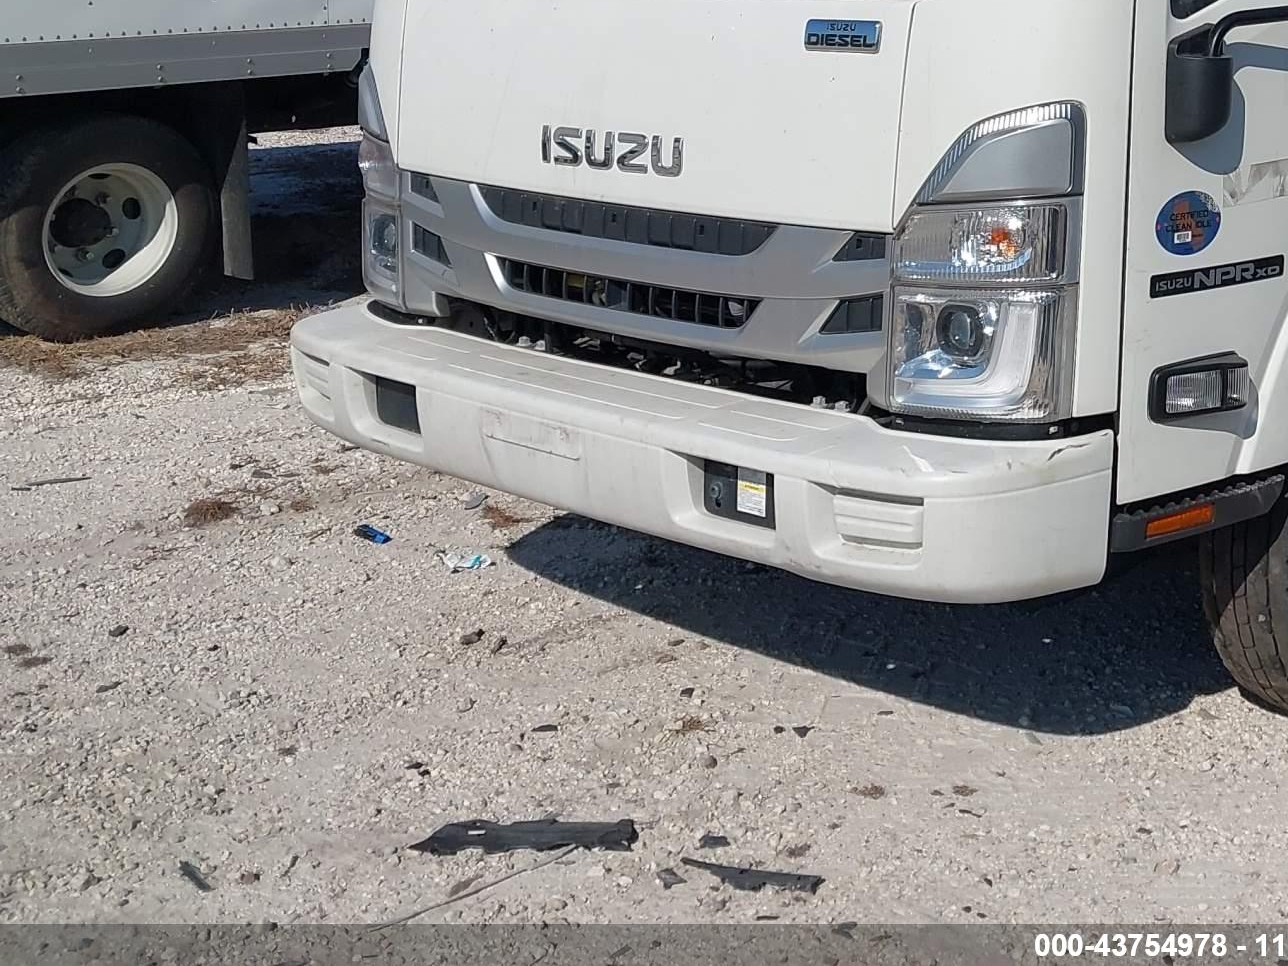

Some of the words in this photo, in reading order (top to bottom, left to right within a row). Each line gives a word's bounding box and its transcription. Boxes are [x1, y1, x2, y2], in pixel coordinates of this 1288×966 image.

[825, 23, 857, 32] ISUZU
[806, 33, 876, 49] DIESEL
[541, 124, 685, 178] ISUZU
[1155, 277, 1192, 292] ISUZU
